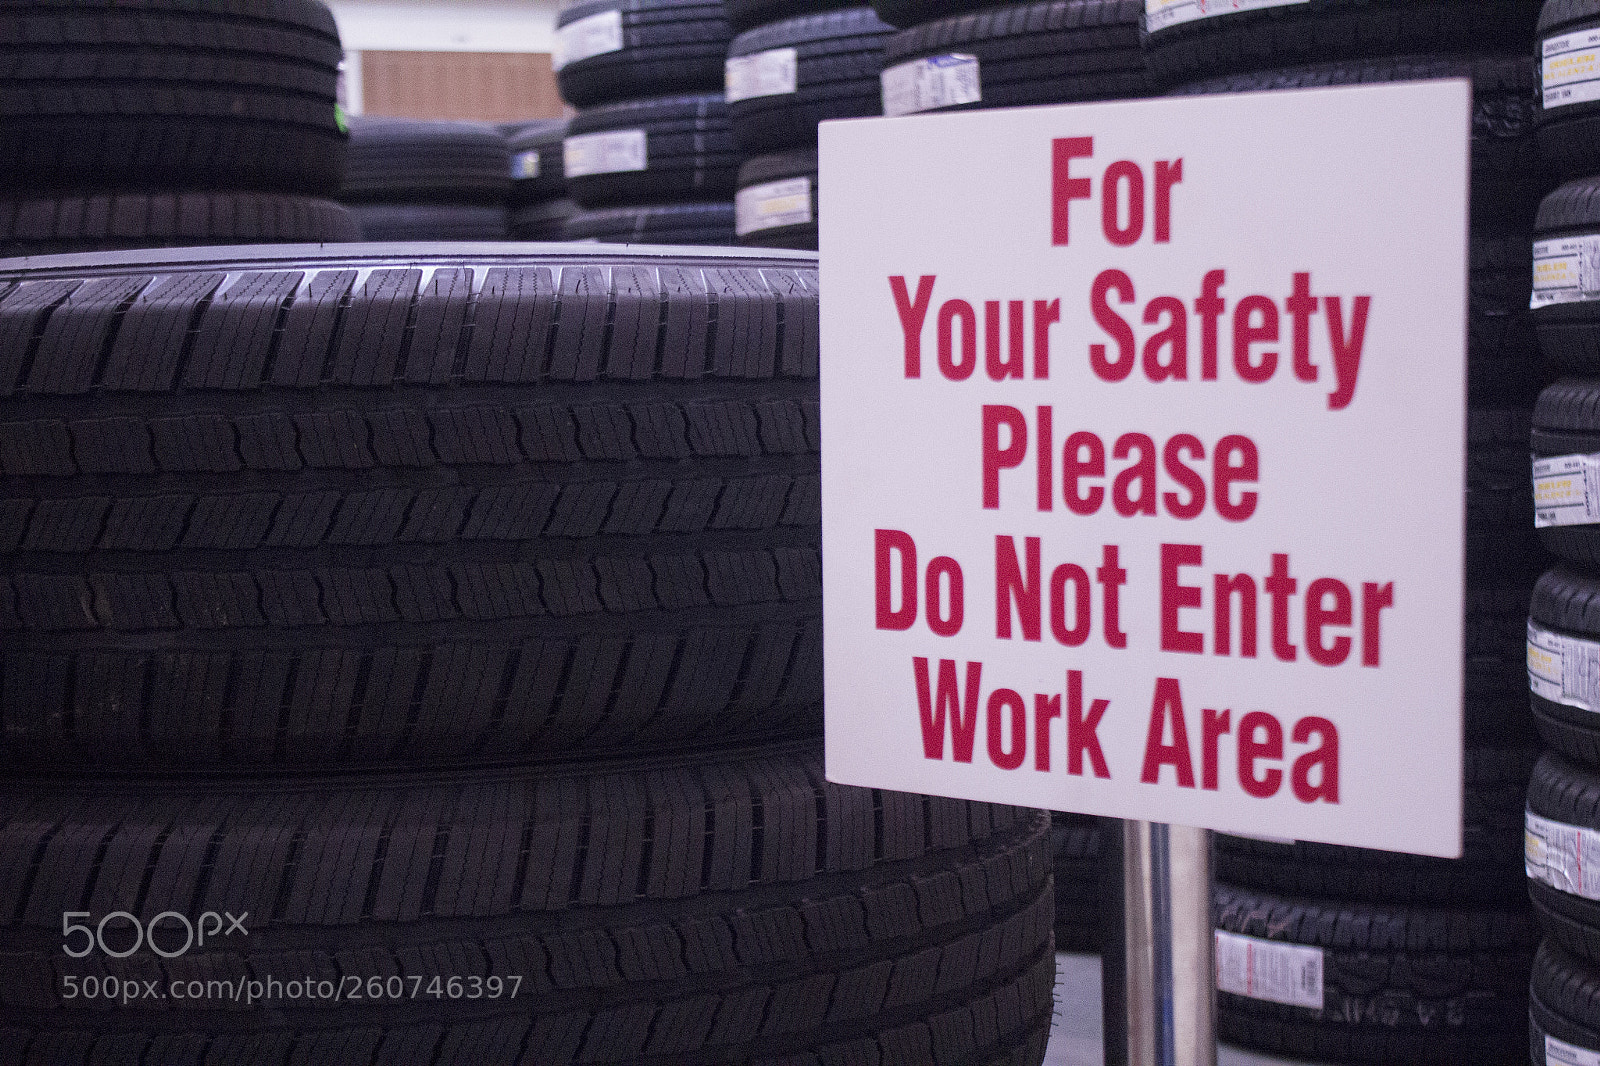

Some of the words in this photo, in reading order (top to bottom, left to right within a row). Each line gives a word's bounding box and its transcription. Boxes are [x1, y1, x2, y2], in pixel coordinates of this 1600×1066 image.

[1051, 135, 1184, 249] For
[887, 274, 1062, 383] Your
[1090, 268, 1372, 411] Safety
[981, 404, 1260, 523] Please
[874, 528, 965, 638] Do
[994, 534, 1128, 650] Not
[1159, 542, 1394, 668] Enter
[911, 656, 1111, 780] Work
[1140, 676, 1341, 805] Area
